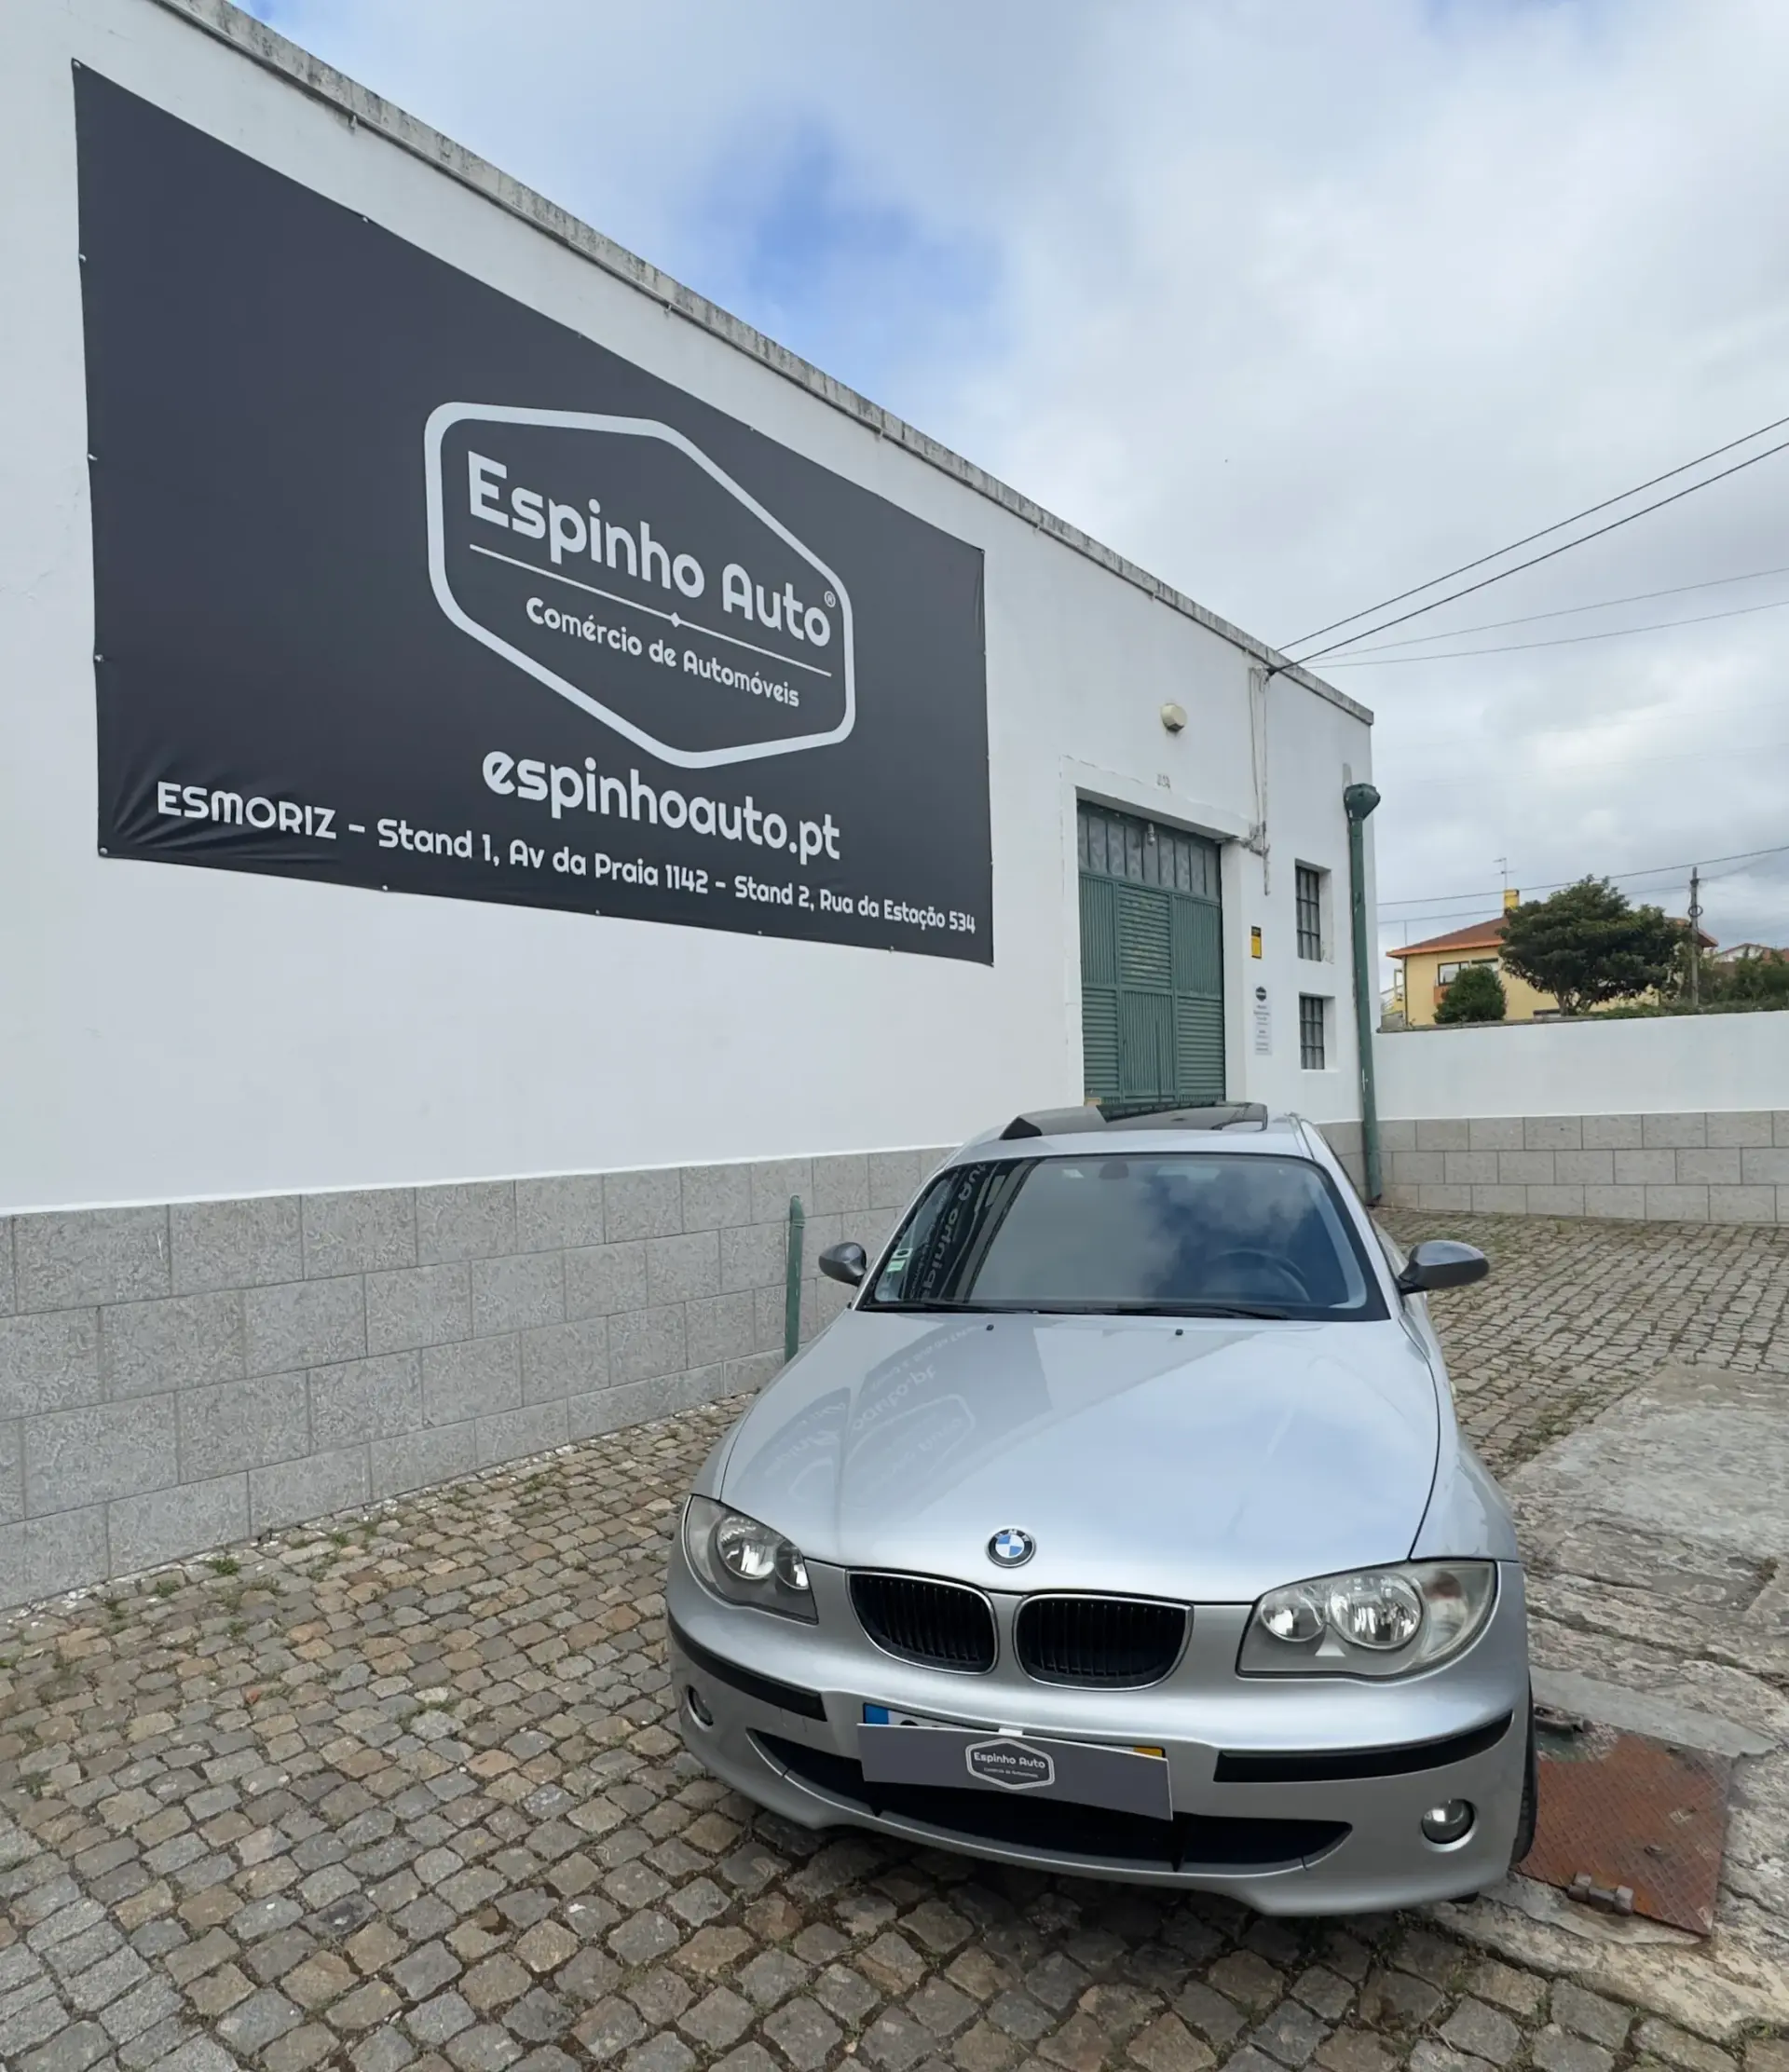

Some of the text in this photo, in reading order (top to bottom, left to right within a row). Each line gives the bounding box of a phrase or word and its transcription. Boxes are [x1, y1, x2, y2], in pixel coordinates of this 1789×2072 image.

[468, 450, 705, 598] Espinho
[722, 563, 831, 648] Auto
[526, 596, 799, 707] Comércio de Automóveis
[157, 781, 337, 839] ESMORIZ
[376, 818, 472, 859] Stand
[482, 834, 500, 866] 1,
[509, 838, 545, 869] Av
[552, 846, 587, 876] da
[594, 852, 659, 886] Praia
[664, 864, 709, 894] 1142
[734, 875, 793, 906] Stand
[798, 885, 814, 912] 2,
[819, 888, 854, 914] Rua
[857, 894, 880, 918] da
[883, 898, 946, 931] Estação
[949, 910, 976, 934] 534
[482, 751, 840, 866] espinhoauto.pt
[974, 1752, 1046, 1768] Espinho Auto
